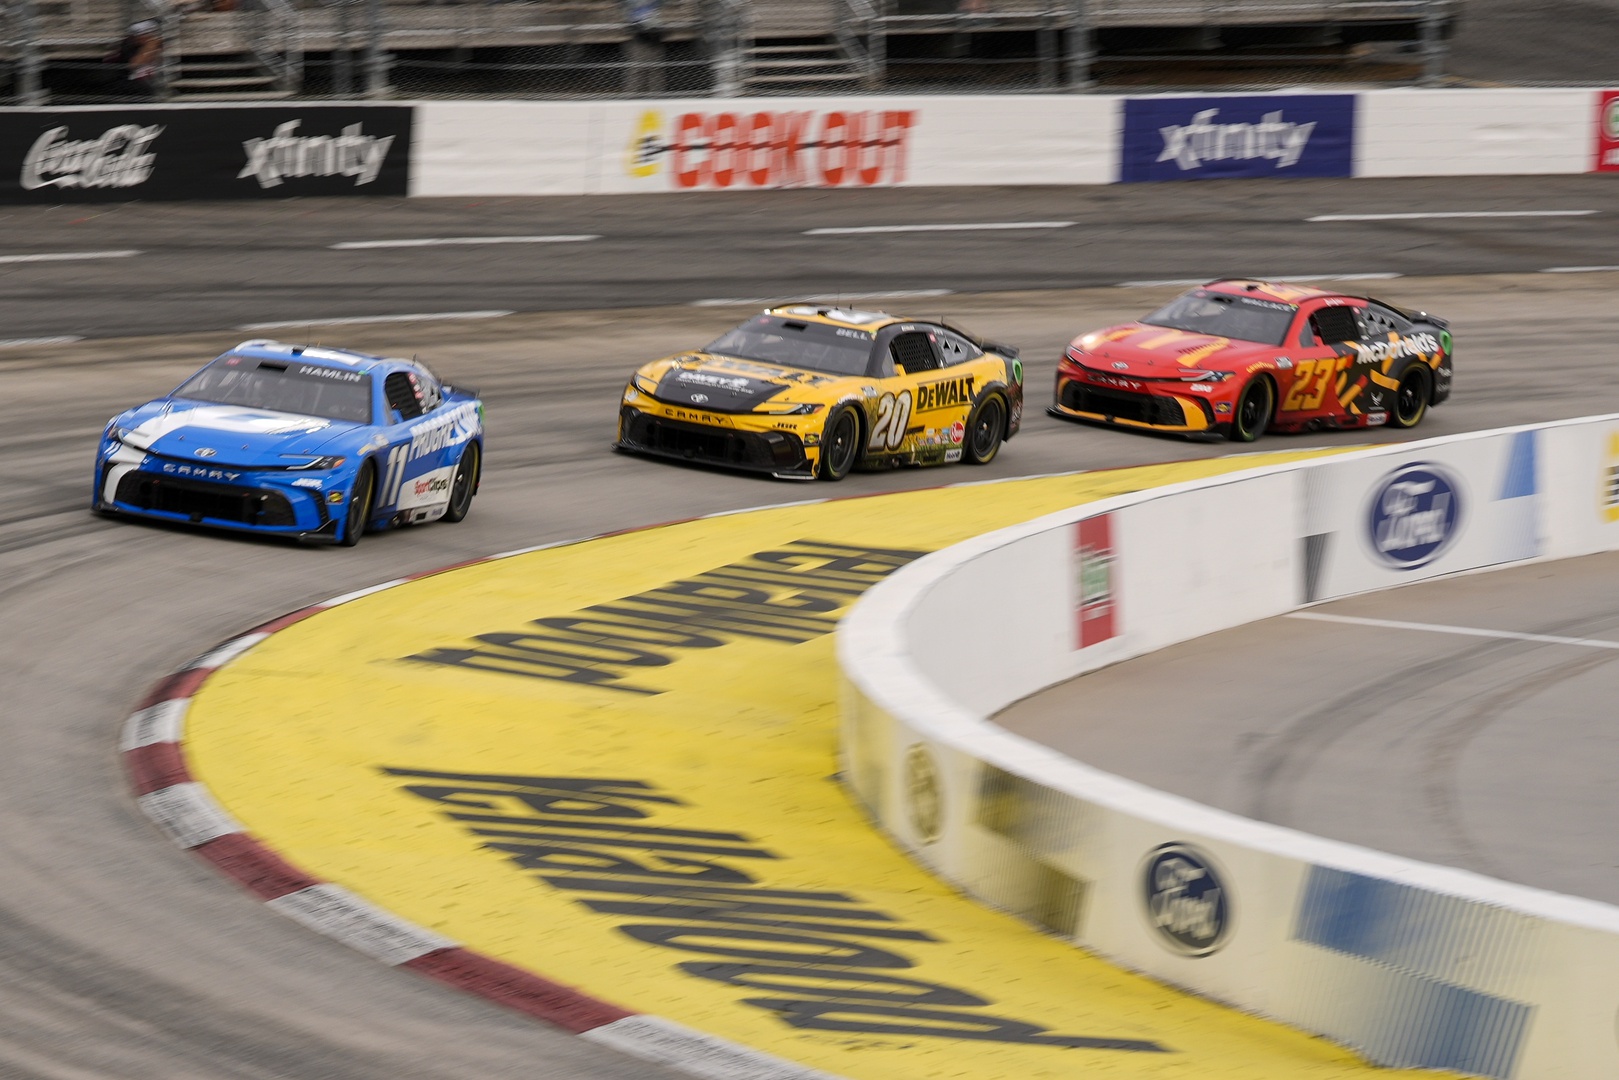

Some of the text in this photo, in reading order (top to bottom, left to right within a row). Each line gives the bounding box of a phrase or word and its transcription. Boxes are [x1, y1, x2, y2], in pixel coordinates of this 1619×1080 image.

[237, 119, 396, 189] xfinity
[1156, 108, 1317, 170] xfinity
[836, 328, 868, 340] BELL
[1356, 332, 1440, 365] McDonald's
[299, 365, 362, 382] HAMLIN
[1281, 356, 1338, 411] 23
[665, 408, 726, 425] CAMRY
[868, 390, 913, 450] 20
[163, 463, 241, 481] CAMRY
[377, 443, 411, 509] 11
